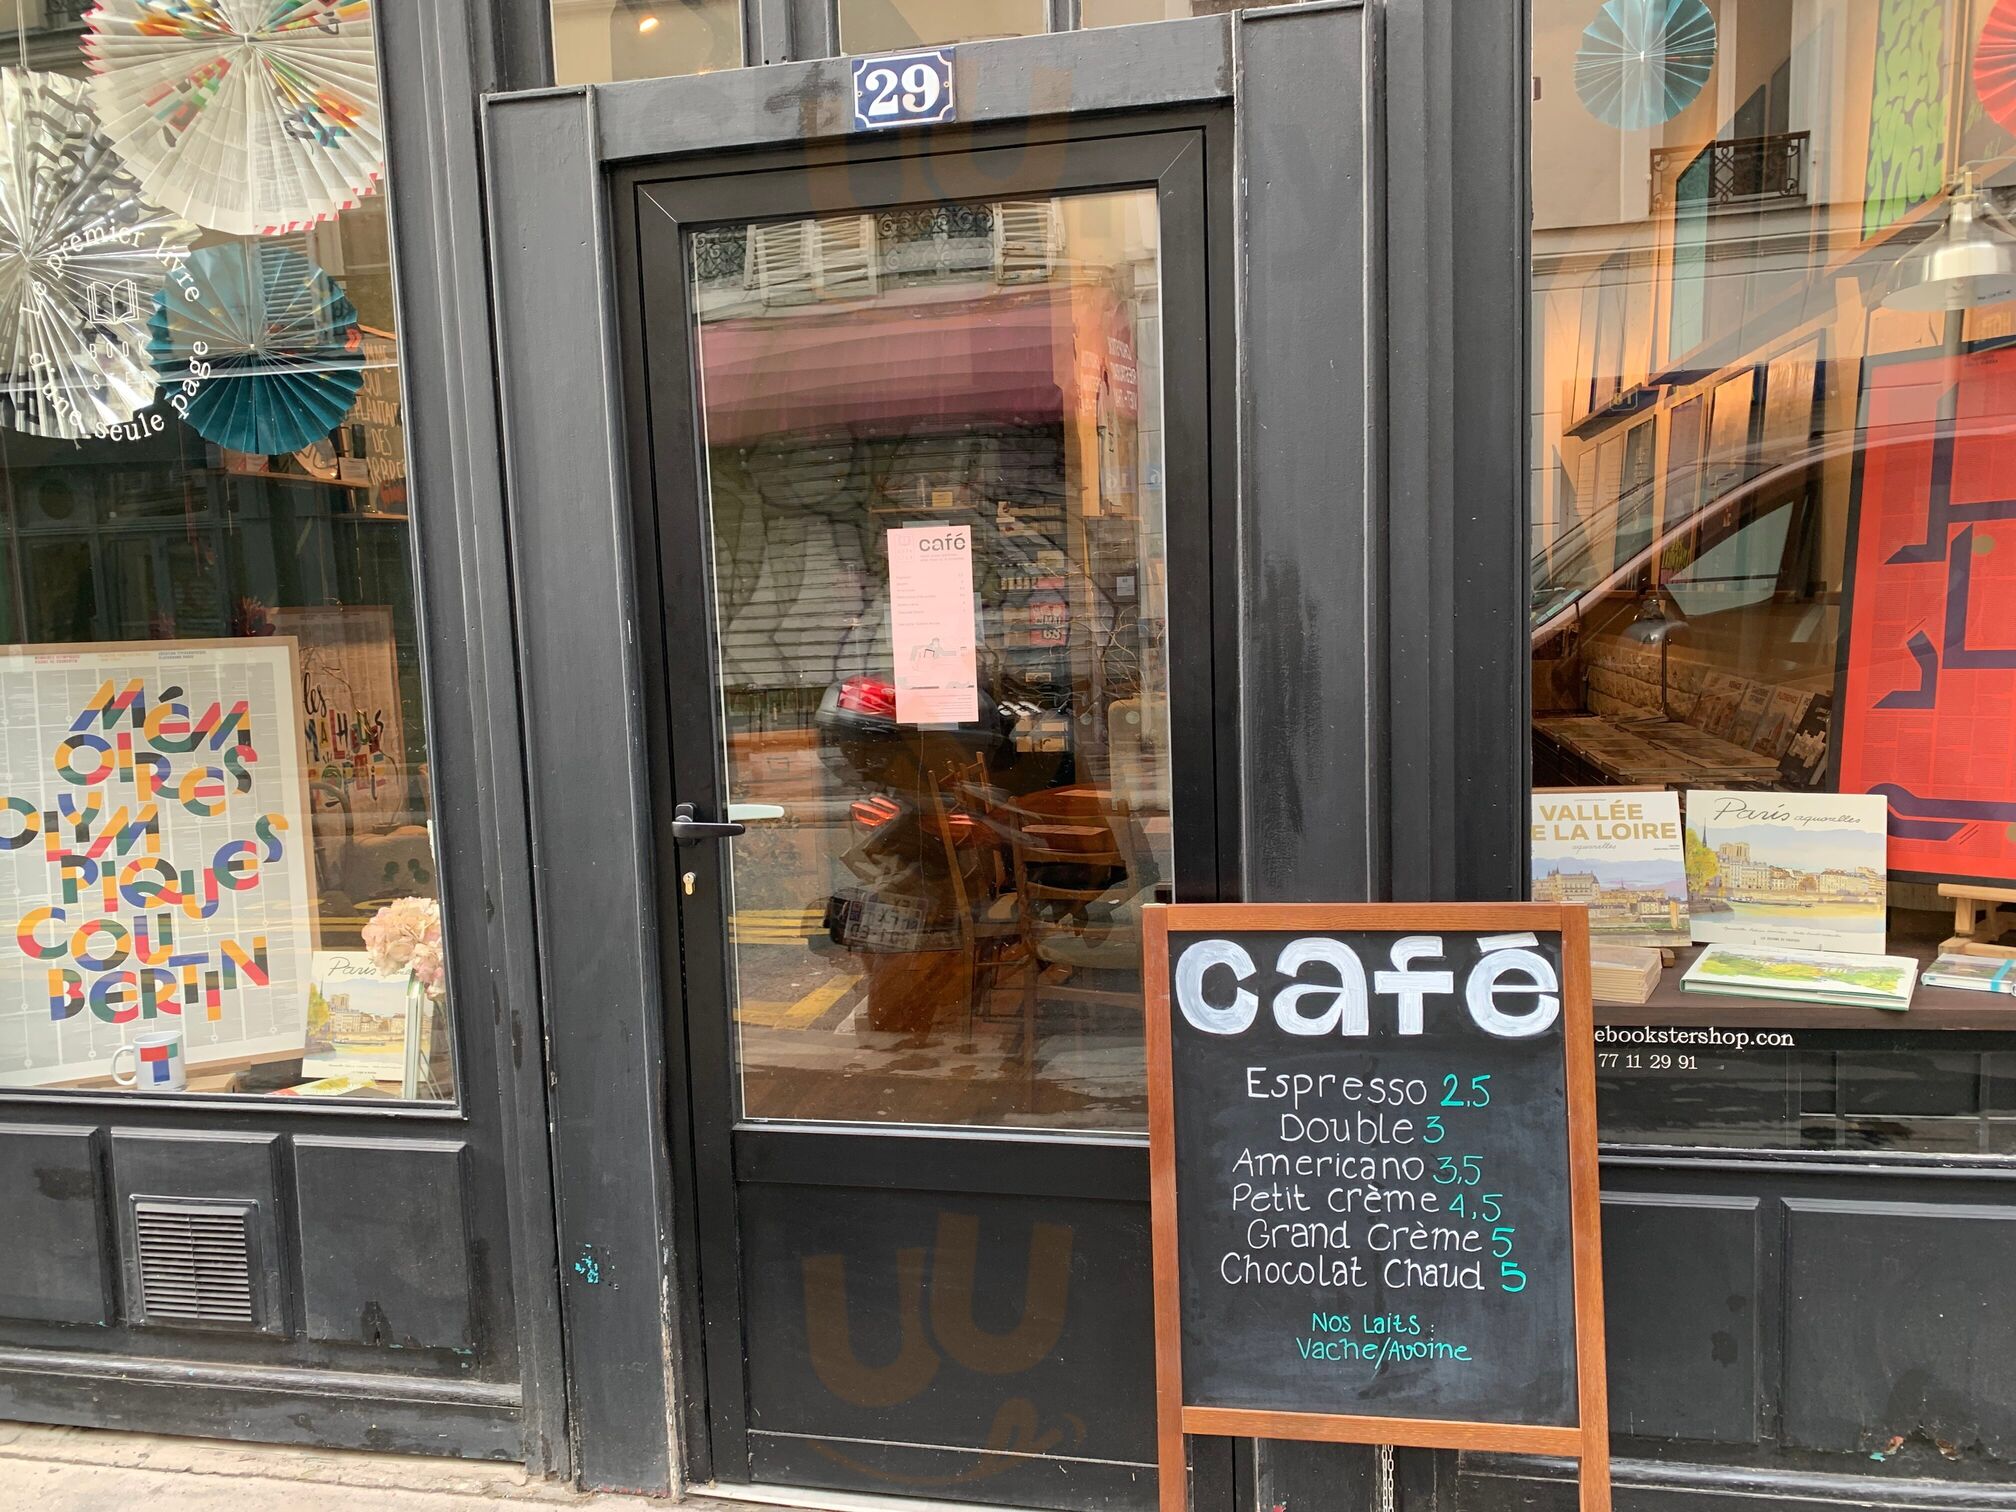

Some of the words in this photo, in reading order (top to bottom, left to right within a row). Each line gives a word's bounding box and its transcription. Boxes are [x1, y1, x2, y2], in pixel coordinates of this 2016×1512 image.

[865, 63, 941, 117] 29
[47, 219, 146, 279] premier
[155, 237, 200, 303] livre
[89, 340, 147, 359] BOOK
[95, 413, 165, 442] seule
[171, 340, 211, 420] page
[919, 533, 966, 552] café
[1538, 800, 1644, 821] VALLÉE
[1714, 796, 1791, 821] Paris
[1531, 825, 1547, 841] E
[1553, 824, 1590, 841] LA
[1596, 822, 1678, 841] LOIRE
[328, 956, 377, 977] Paris
[1175, 931, 1561, 1038] café
[1598, 1053, 1619, 1068] 77
[1626, 1054, 1642, 1069] 11
[1649, 1054, 1672, 1070] 29
[1678, 1055, 1698, 1070] 91
[1246, 1066, 1427, 1110] Espresso
[1280, 1110, 1414, 1144] Double
[1423, 1115, 1446, 1144] 3
[1232, 1147, 1425, 1181] Americano
[1432, 1155, 1484, 1186] 3,5
[1232, 1182, 1311, 1213] Petit
[1448, 1193, 1504, 1222] 4,5
[1247, 1218, 1351, 1250] Grand
[1491, 1227, 1515, 1258] 5
[1220, 1251, 1368, 1287] Chocolat
[1501, 1261, 1528, 1292] 5
[1312, 1311, 1352, 1333] Nos
[1363, 1312, 1421, 1335] Laits
